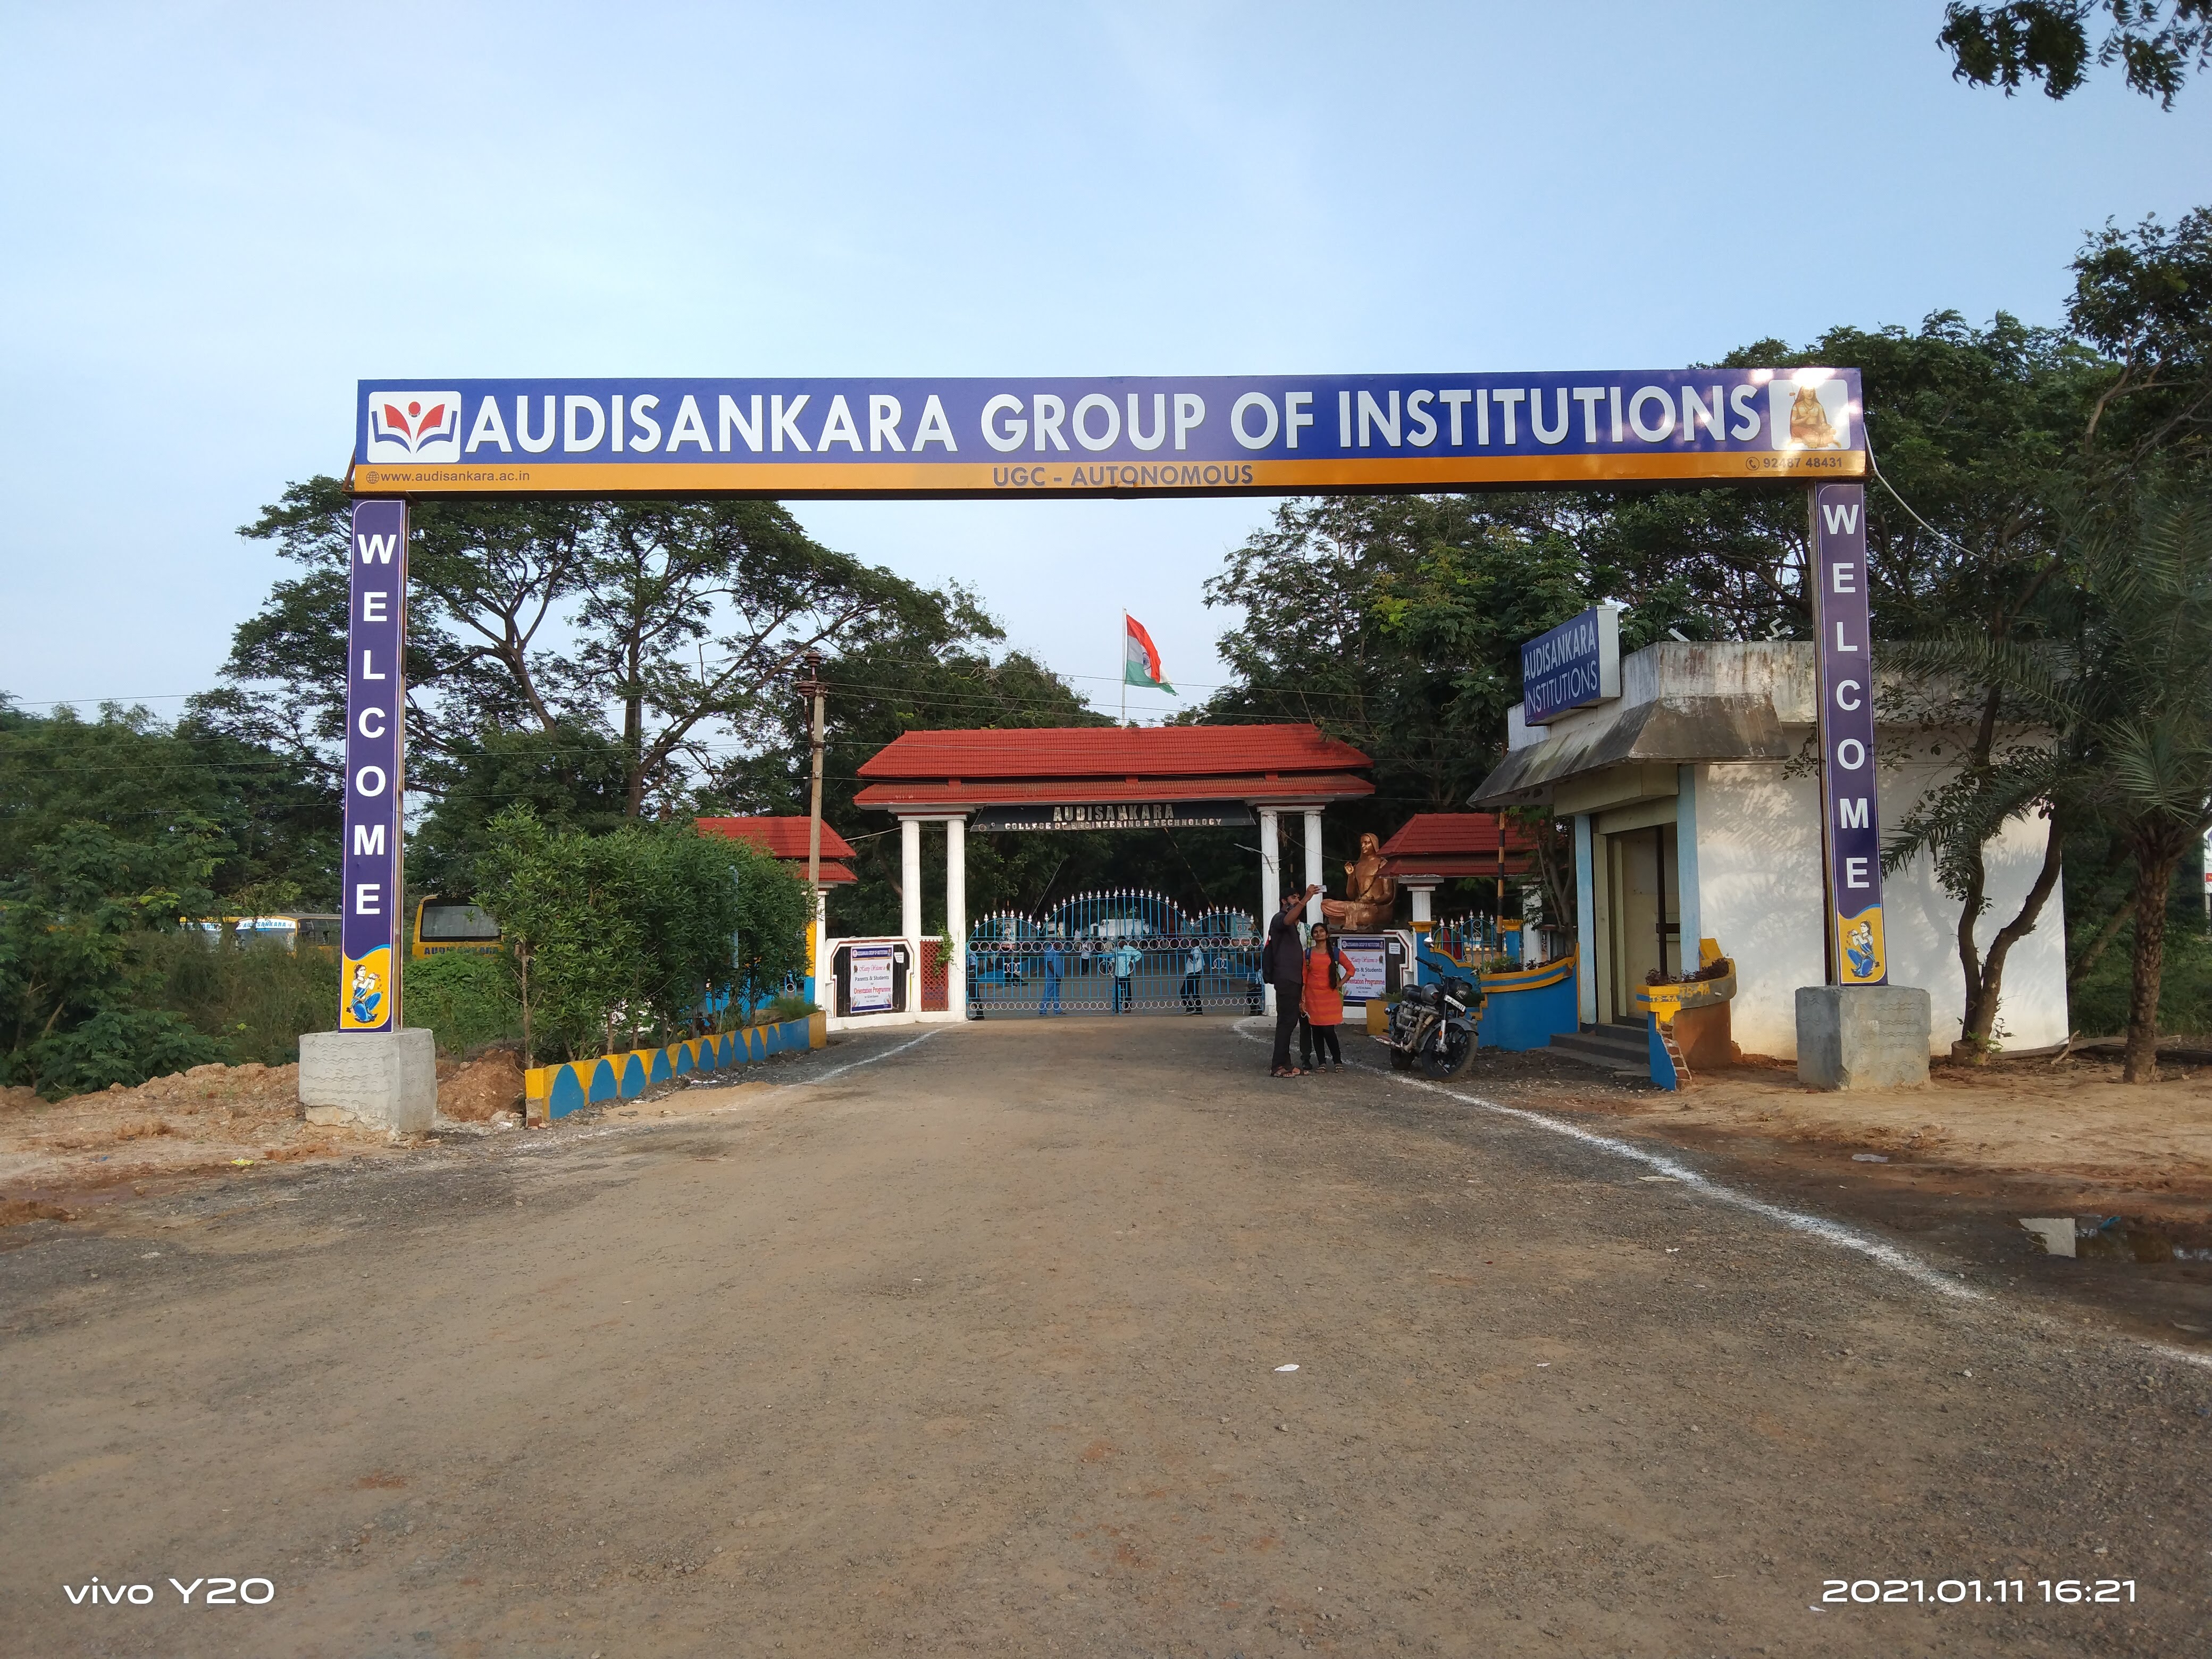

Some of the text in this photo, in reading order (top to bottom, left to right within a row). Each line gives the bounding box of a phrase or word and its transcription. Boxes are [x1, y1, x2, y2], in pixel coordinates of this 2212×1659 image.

[464, 384, 1762, 455] AUDISANKARA GROUP OF INSTITUTIONS
[381, 470, 530, 482] www.audisankara.ac.in
[993, 466, 1045, 487] UGC
[1070, 465, 1253, 486] AUTONOMOUS
[1763, 456, 1842, 468] 92487 48431
[1524, 620, 1596, 683] AUDISANKARA
[1525, 660, 1597, 717] INSTITUTIONS
[1823, 504, 1870, 890] WELCOME
[354, 534, 397, 916] WELCOME
[1053, 804, 1174, 822] AUDISANKARA
[1071, 820, 1141, 830] ENGINEERING
[1153, 818, 1222, 827] TECHNOLOGY
